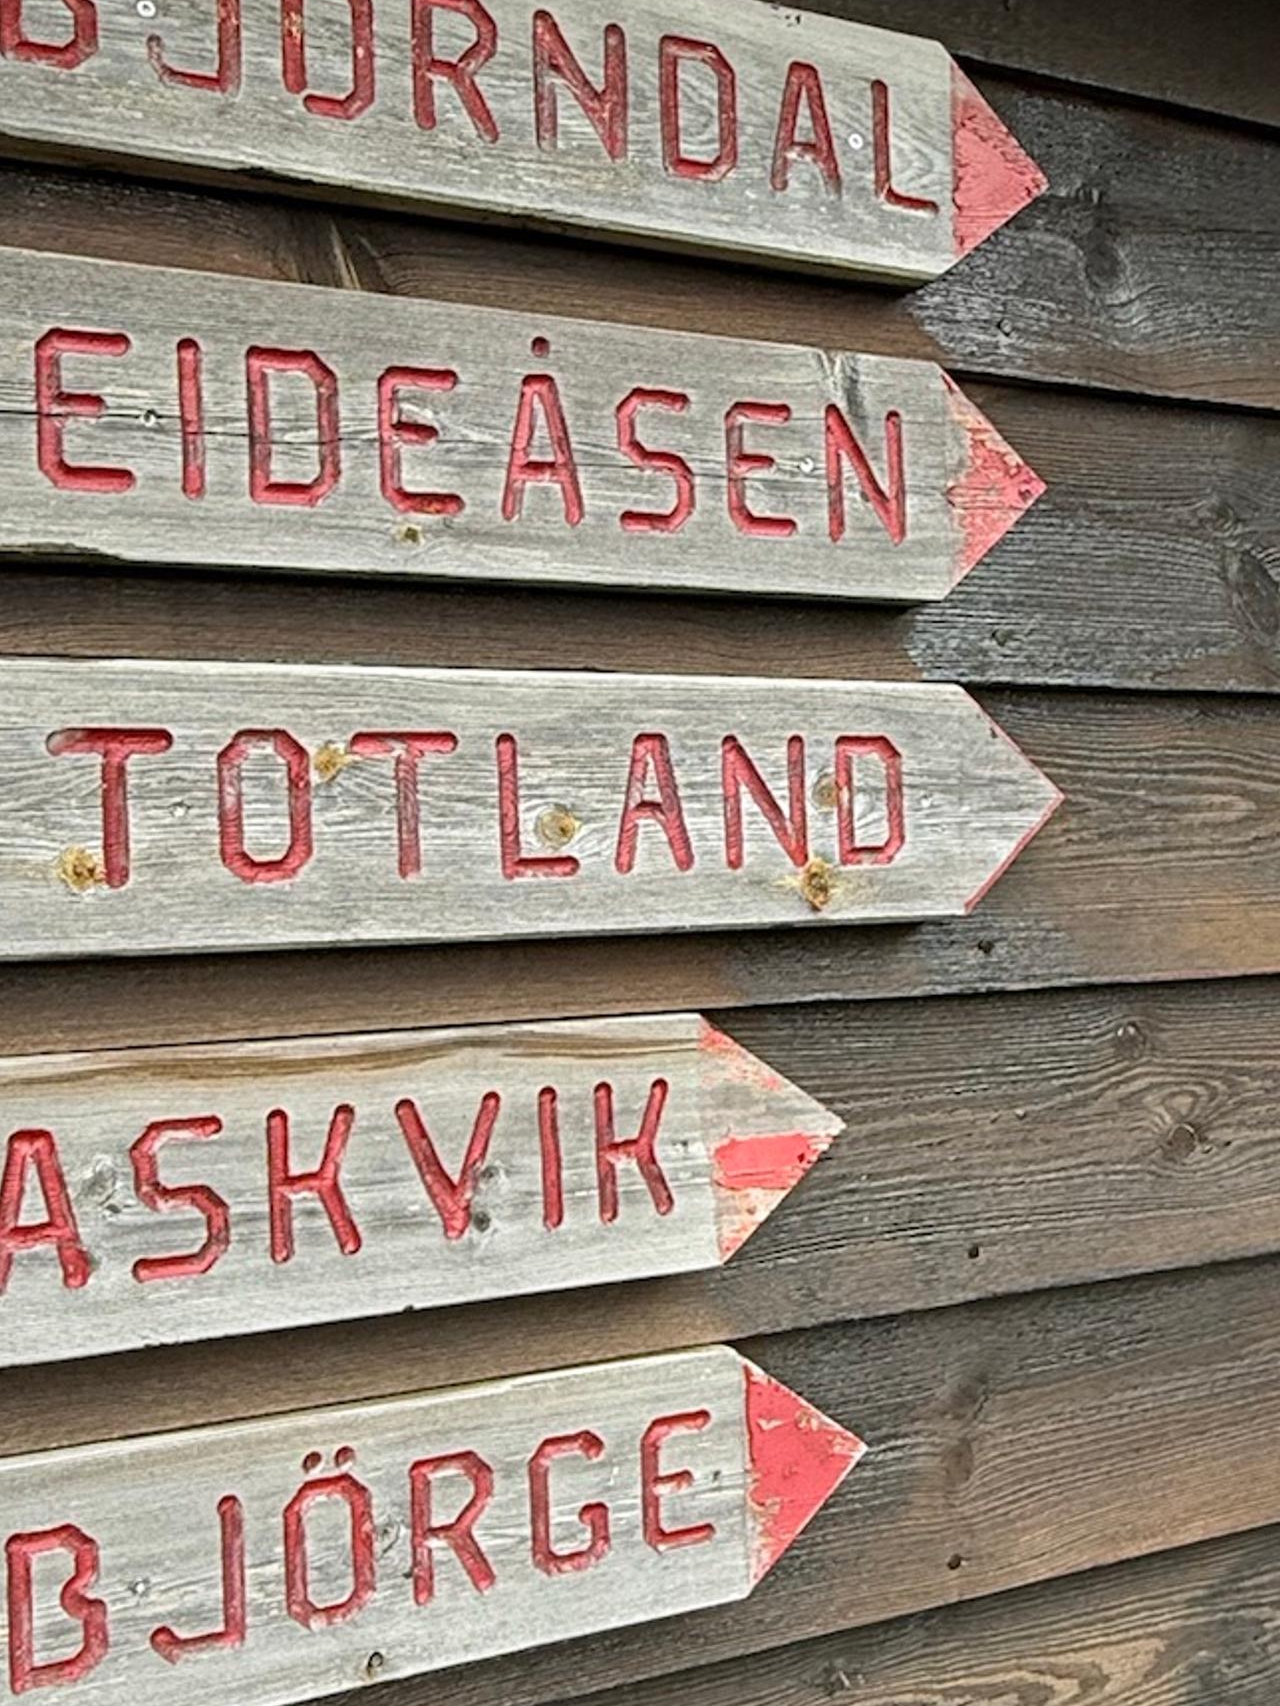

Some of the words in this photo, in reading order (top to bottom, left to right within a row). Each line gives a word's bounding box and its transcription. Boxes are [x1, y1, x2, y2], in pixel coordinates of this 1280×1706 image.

[32, 327, 908, 546] EIDEÅSEN
[45, 726, 907, 890] TOTLAND
[3, 1408, 717, 1695] BJÖRGE
